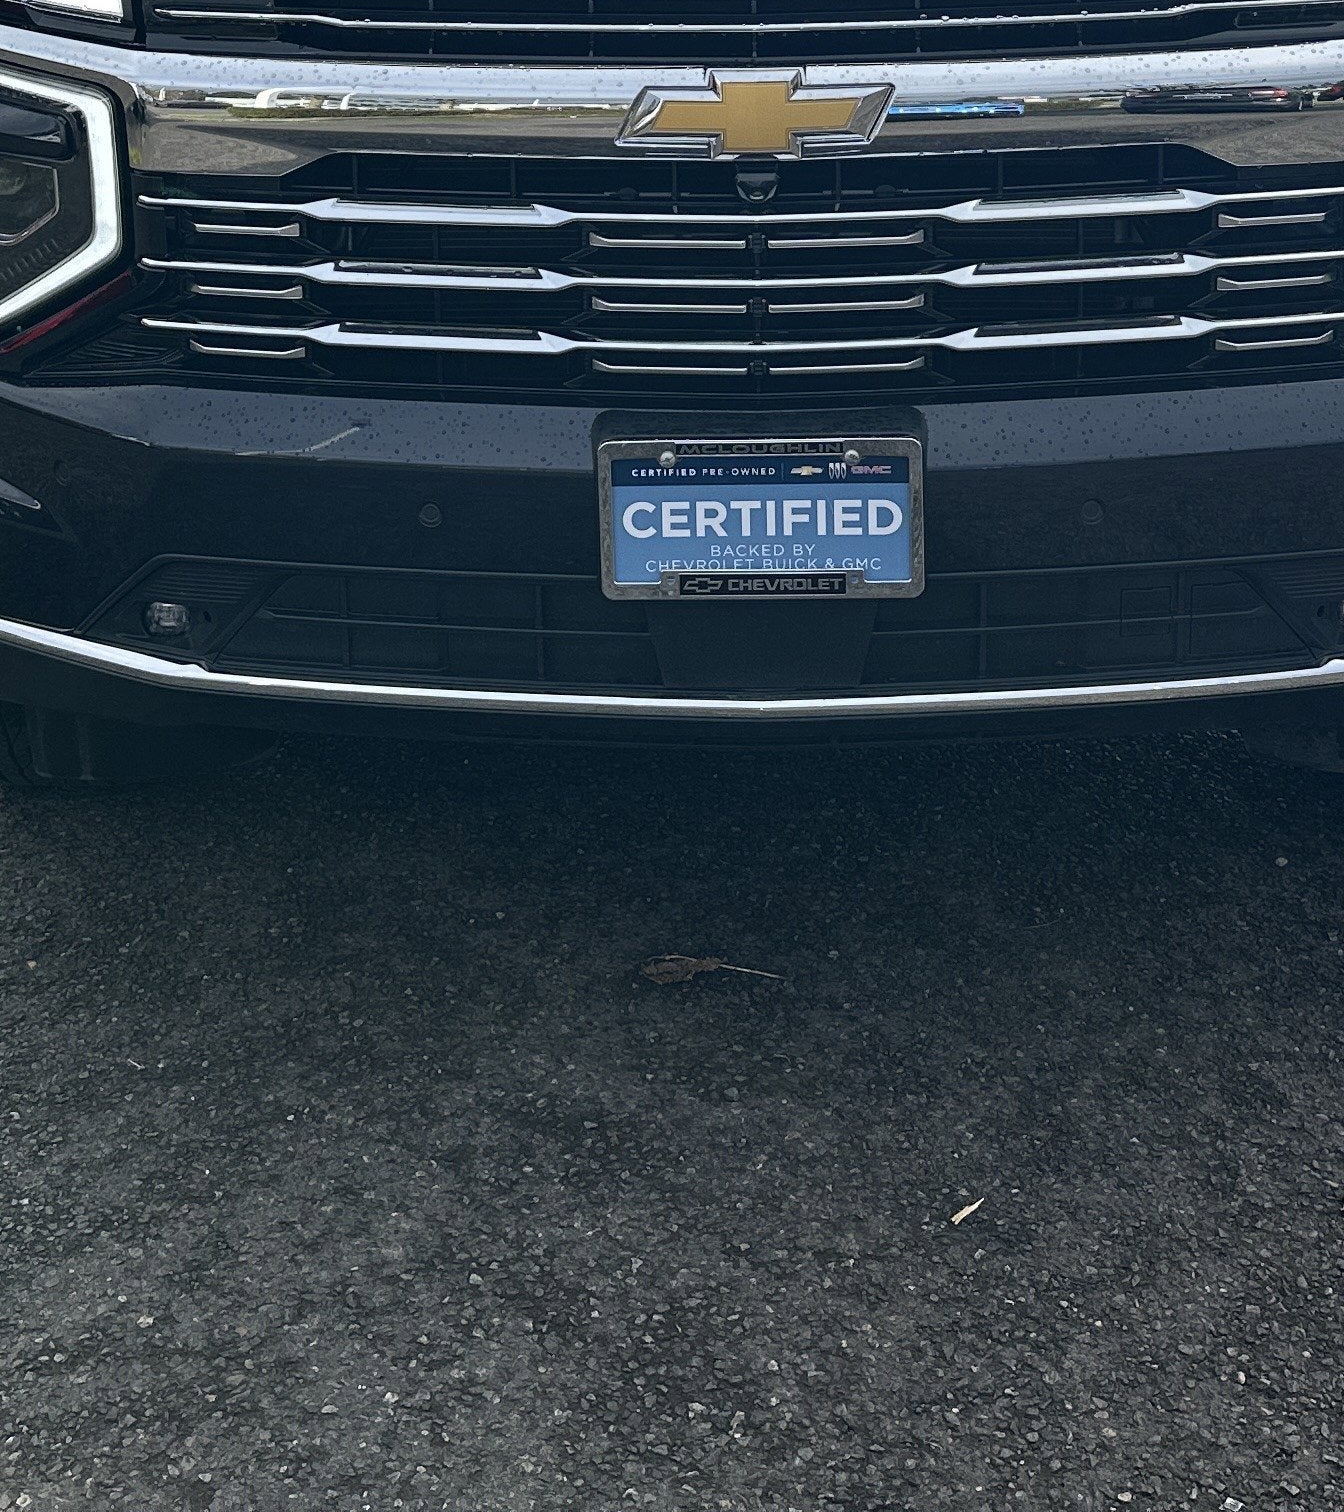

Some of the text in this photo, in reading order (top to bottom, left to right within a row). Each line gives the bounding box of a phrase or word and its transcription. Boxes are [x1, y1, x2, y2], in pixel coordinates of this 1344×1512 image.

[679, 443, 841, 455] MCLOUGHLIN
[631, 466, 776, 477] CERTIFIED PRE-OWNED
[622, 499, 903, 539] CERTIFIED
[710, 543, 816, 557] BACKED BY
[645, 557, 882, 572] CHEVROLET BUICK & GMC
[727, 578, 845, 591] CHEVROLET
